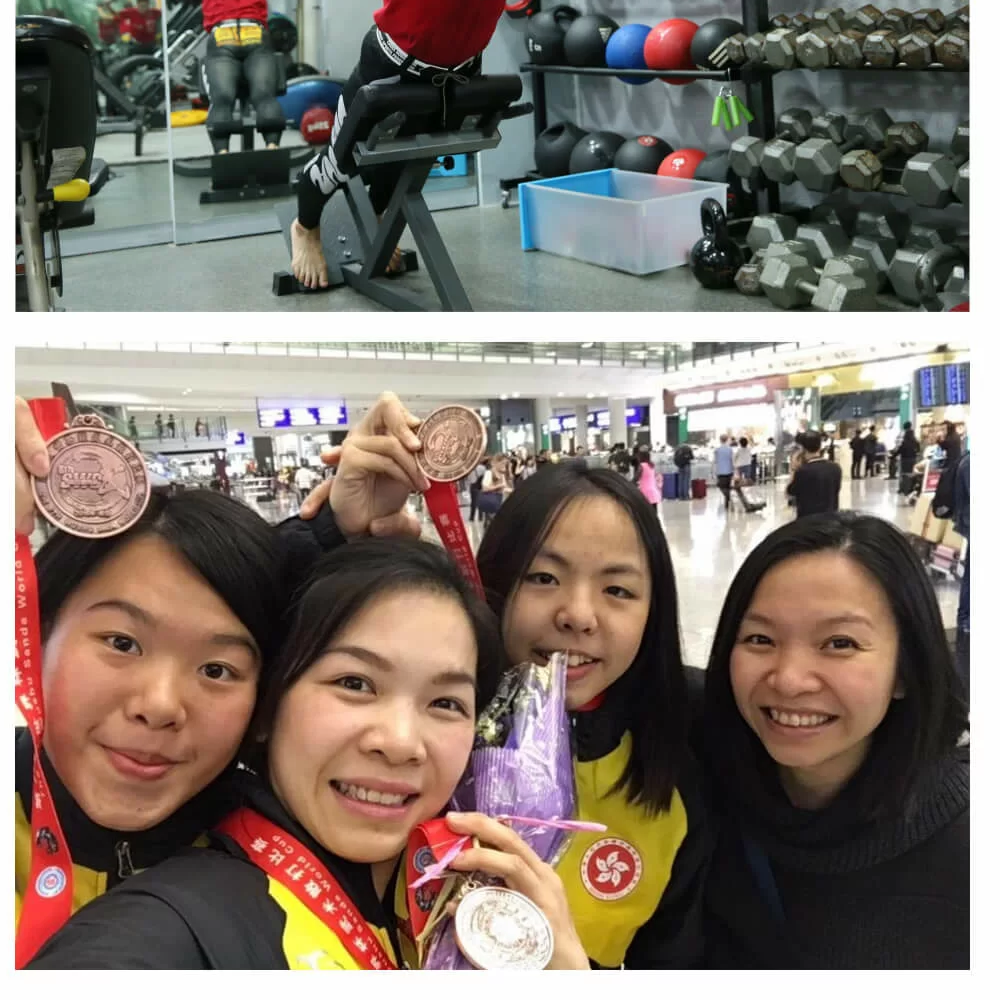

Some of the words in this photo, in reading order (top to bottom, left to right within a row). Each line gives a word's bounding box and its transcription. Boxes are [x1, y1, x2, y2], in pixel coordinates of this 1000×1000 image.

[15, 559, 26, 609] World
[18, 617, 32, 669] Sanda
[271, 834, 295, 855] Cup
[297, 855, 332, 893] World
